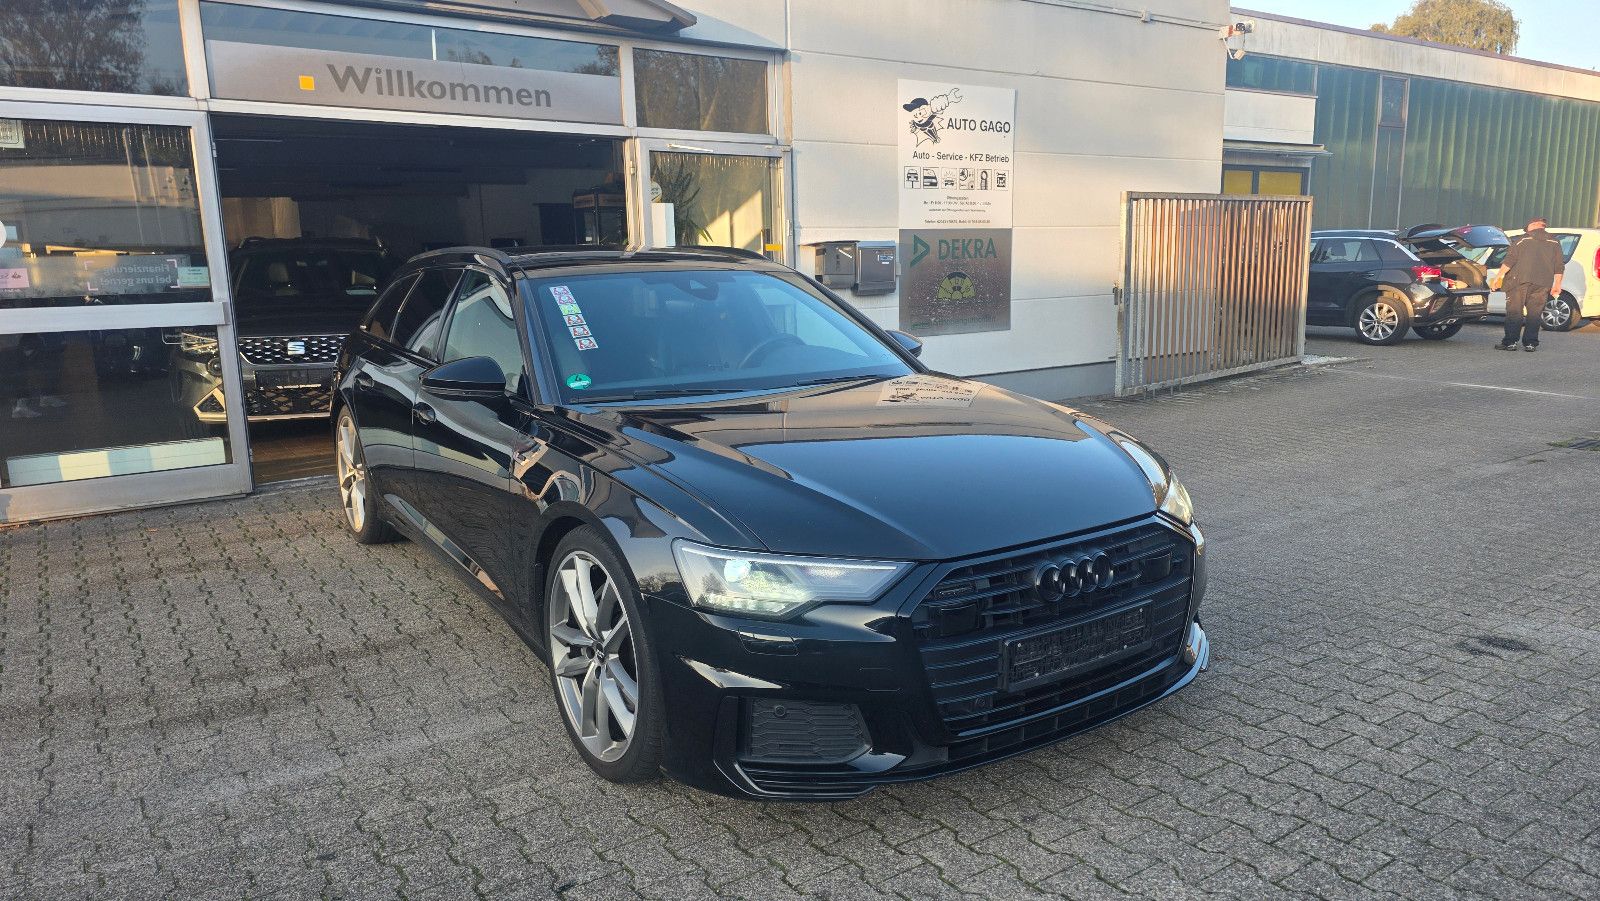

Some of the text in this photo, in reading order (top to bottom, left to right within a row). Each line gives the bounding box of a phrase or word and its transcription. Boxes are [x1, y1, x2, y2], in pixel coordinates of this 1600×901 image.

[327, 63, 552, 108] Willkommen
[947, 118, 1011, 133] AUTO GAGO
[912, 151, 930, 160] Auto
[936, 152, 963, 161] Service
[969, 153, 984, 161] KFZ
[985, 154, 1010, 163] Betrieb
[938, 238, 997, 260] DEKRA
